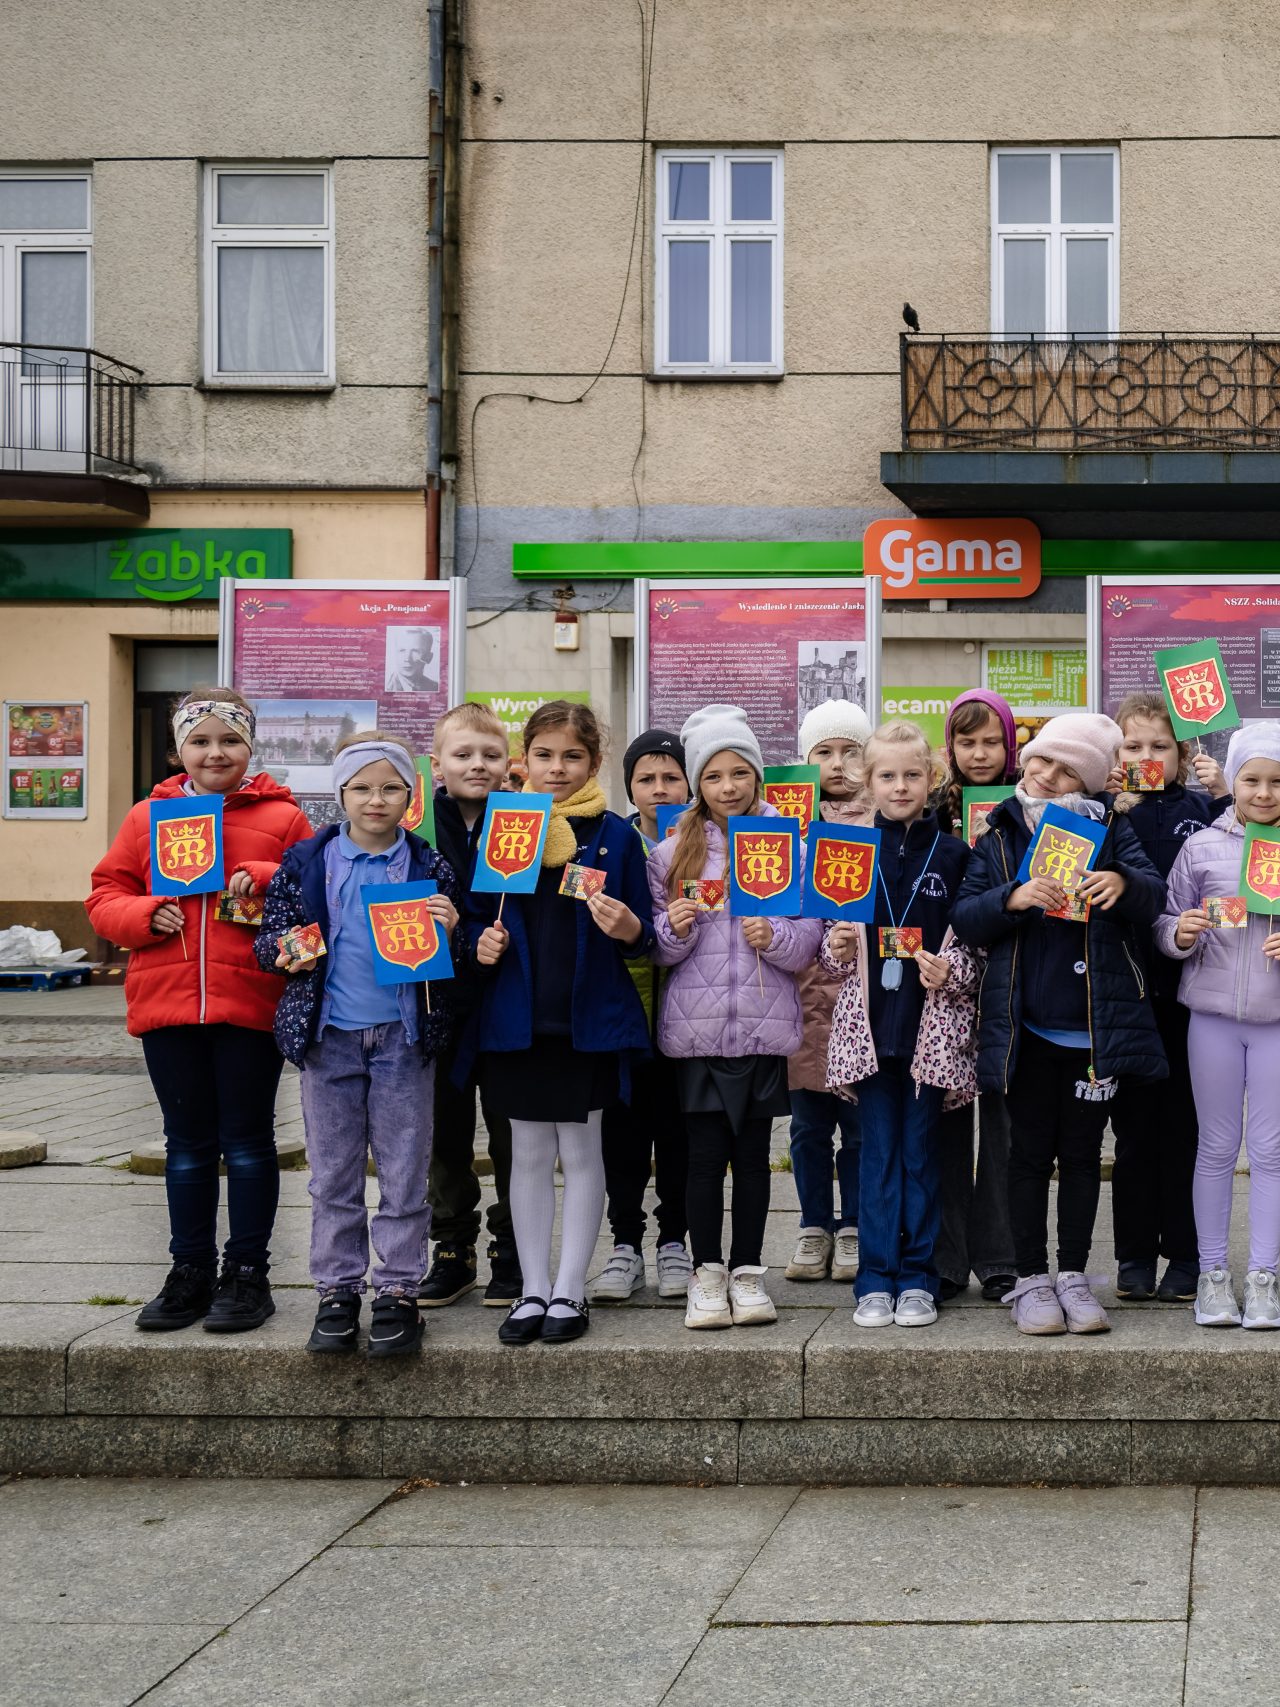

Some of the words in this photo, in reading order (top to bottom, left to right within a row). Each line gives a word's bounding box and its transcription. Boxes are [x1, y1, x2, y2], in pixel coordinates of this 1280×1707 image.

[109, 540, 266, 580] żabka
[880, 529, 1022, 588] Gama
[359, 603, 381, 614] Akcja
[738, 602, 787, 612] Wysiedlenie
[789, 602, 793, 610] i
[794, 602, 840, 611] zniszczenie
[841, 602, 865, 611] Jasła
[1224, 598, 1250, 606] NSZZ
[491, 697, 546, 716] Wyro
